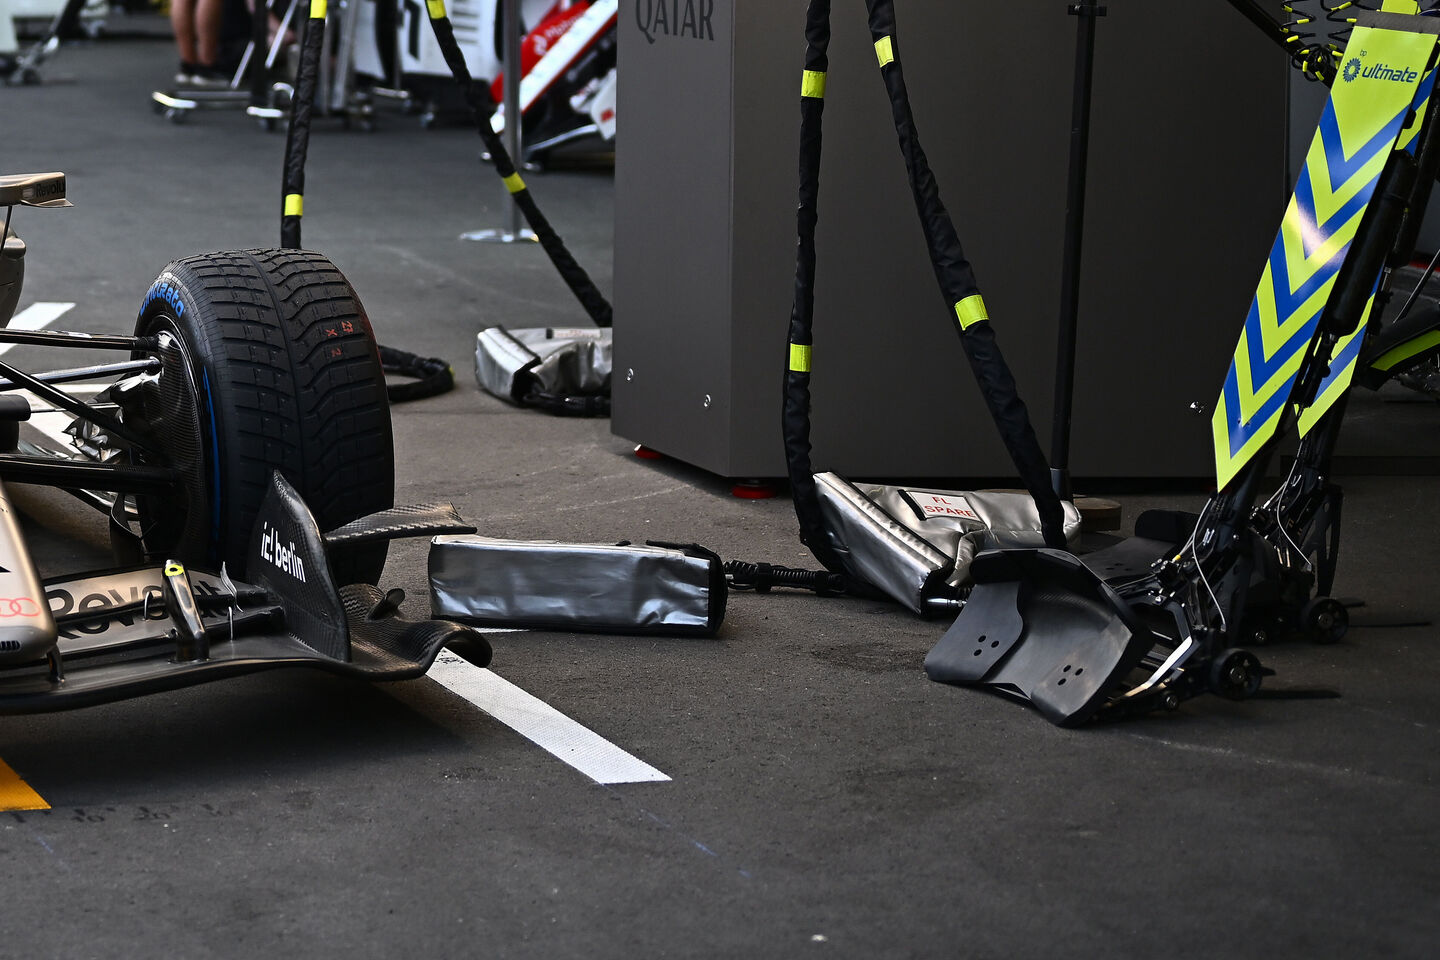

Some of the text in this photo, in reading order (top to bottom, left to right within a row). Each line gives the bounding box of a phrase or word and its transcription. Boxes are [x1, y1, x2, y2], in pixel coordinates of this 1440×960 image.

[1362, 63, 1418, 83] ultimate
[924, 505, 976, 518] SPARE
[261, 521, 306, 583] ic! berlin
